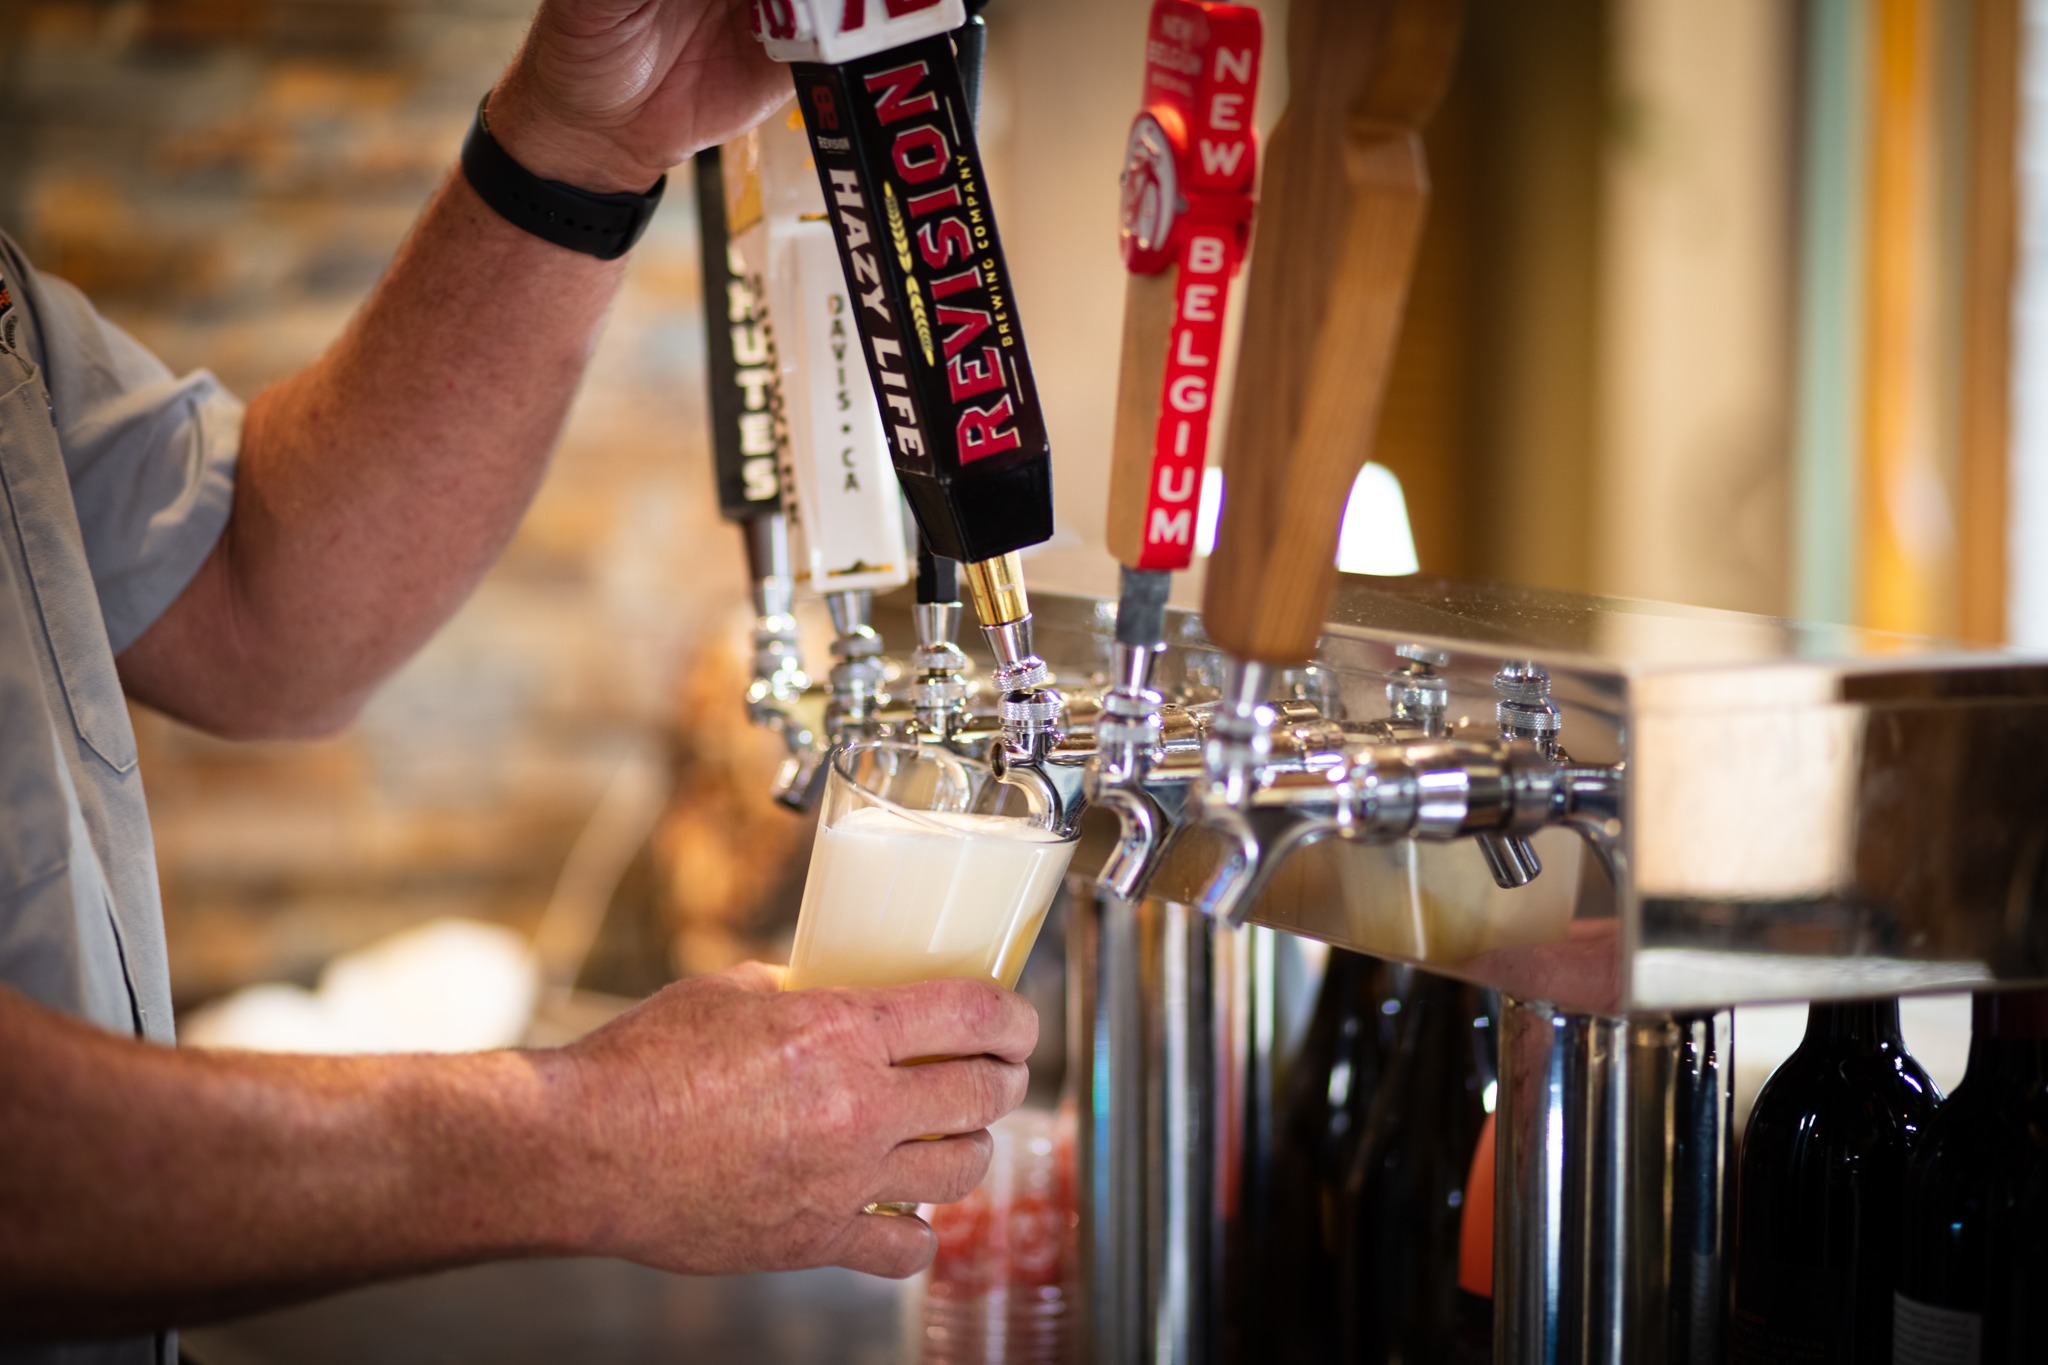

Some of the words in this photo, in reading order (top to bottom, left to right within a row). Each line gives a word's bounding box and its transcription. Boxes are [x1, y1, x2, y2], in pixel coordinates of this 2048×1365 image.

[957, 154, 992, 250] COMPANY
[1200, 46, 1253, 177] NEW
[828, 168, 892, 324] HAZY
[871, 336, 925, 458] LIFE
[863, 60, 1022, 466] REVISION
[983, 258, 1013, 348] BREWING
[827, 294, 851, 412] DAVIS
[841, 446, 860, 494] CA
[1148, 237, 1225, 547] BELGIUM
